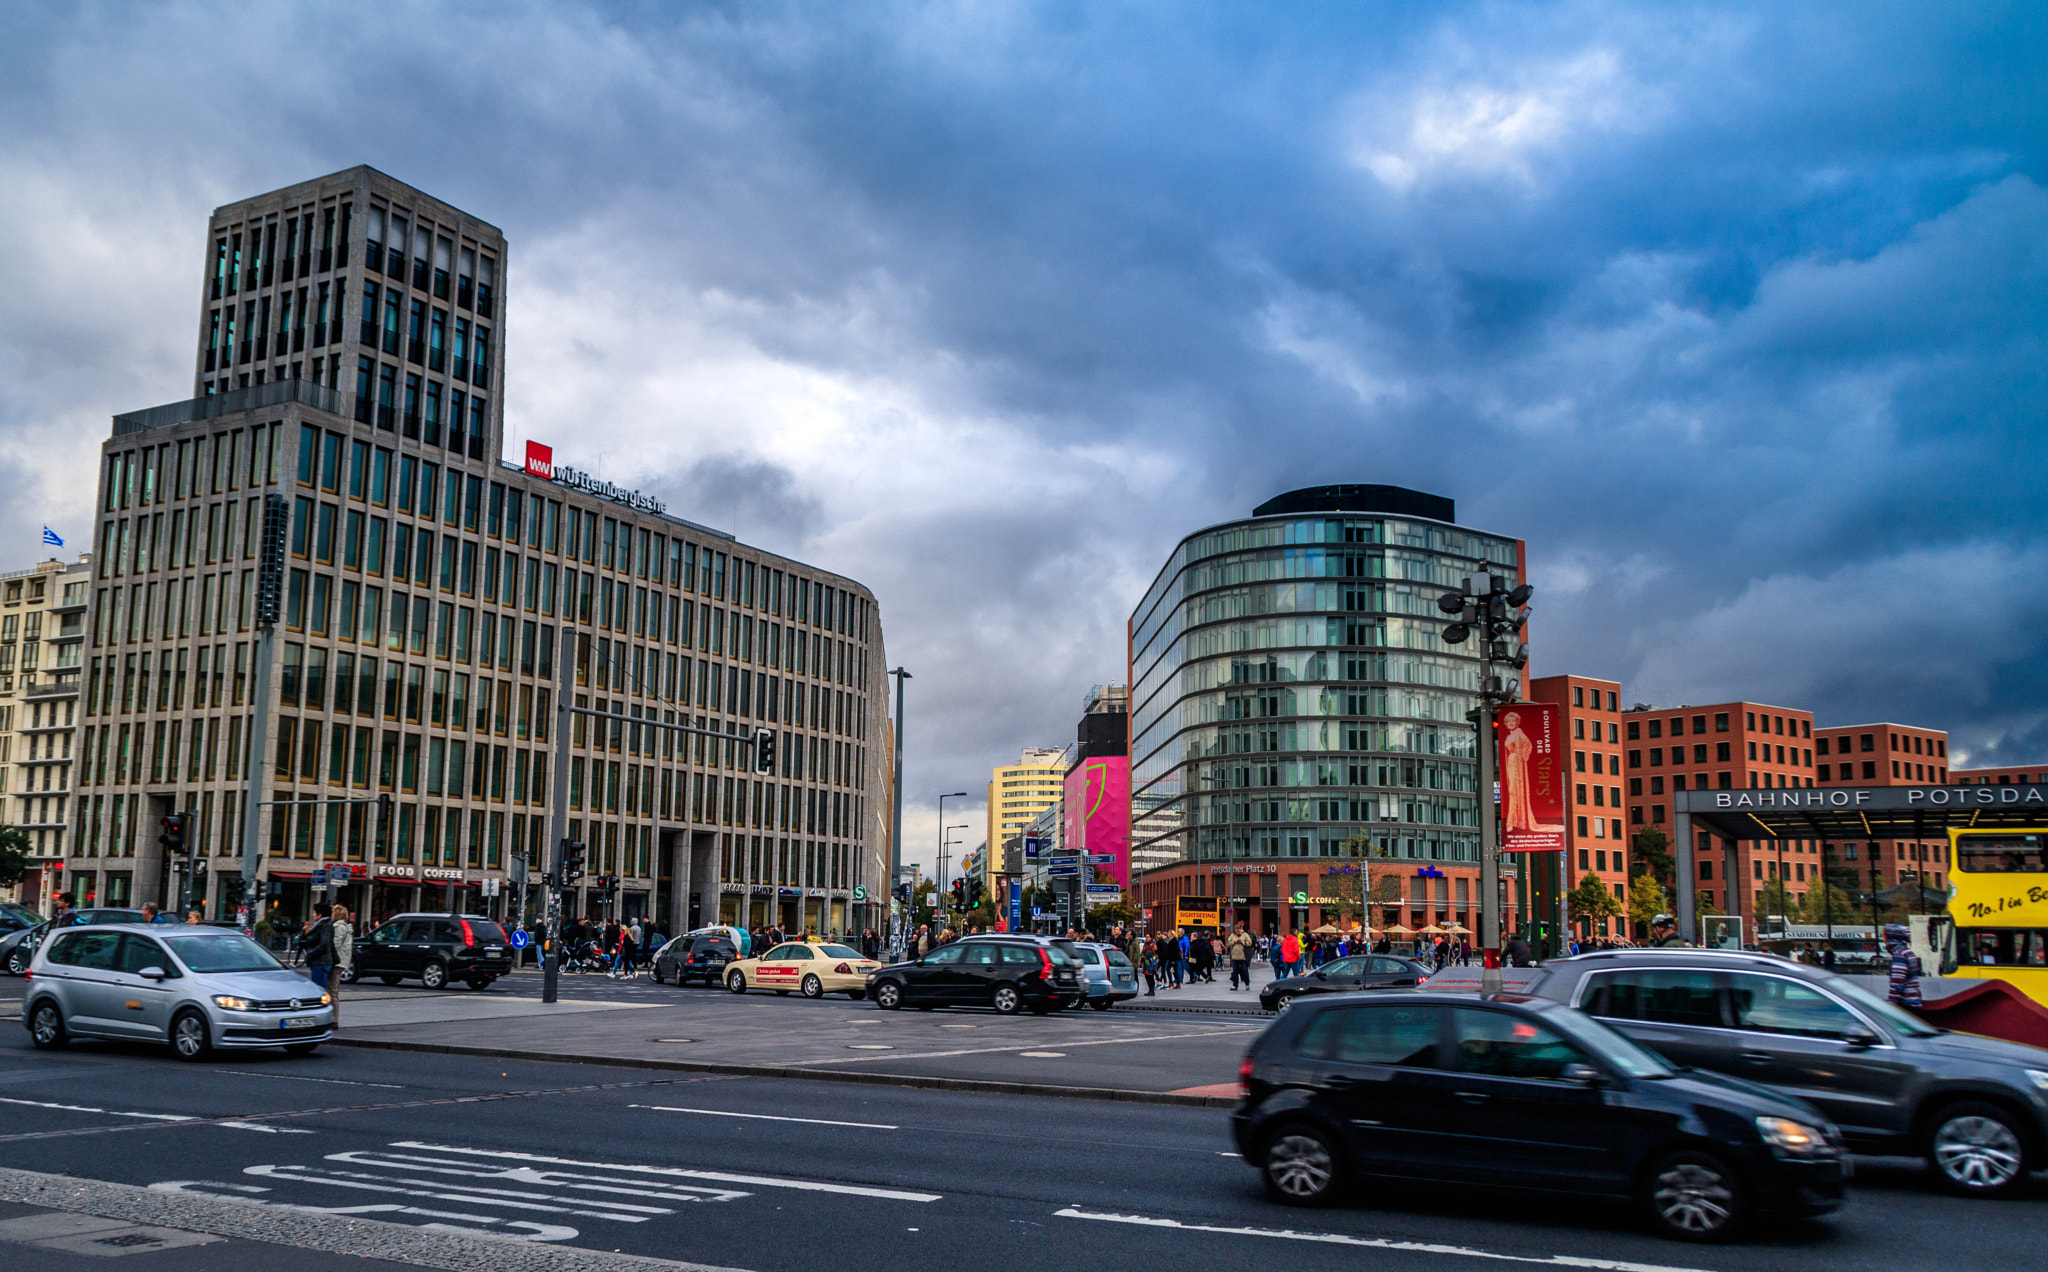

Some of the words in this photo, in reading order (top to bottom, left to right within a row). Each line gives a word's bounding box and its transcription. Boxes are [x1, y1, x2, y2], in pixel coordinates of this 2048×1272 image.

[554, 467, 667, 513] württembergische
[1543, 710, 1551, 754] BOULEVARD
[1536, 756, 1553, 797] Stars
[1716, 791, 1871, 807] BAHNHOF
[1908, 787, 2045, 804] POTSDA
[379, 866, 414, 877] FOOD
[424, 868, 463, 879] COFFEE
[1246, 864, 1264, 873] Platz
[1267, 864, 1276, 873] 10
[1418, 865, 1443, 878] Regus
[1968, 902, 1997, 918] No.
[2008, 897, 2022, 908] in
